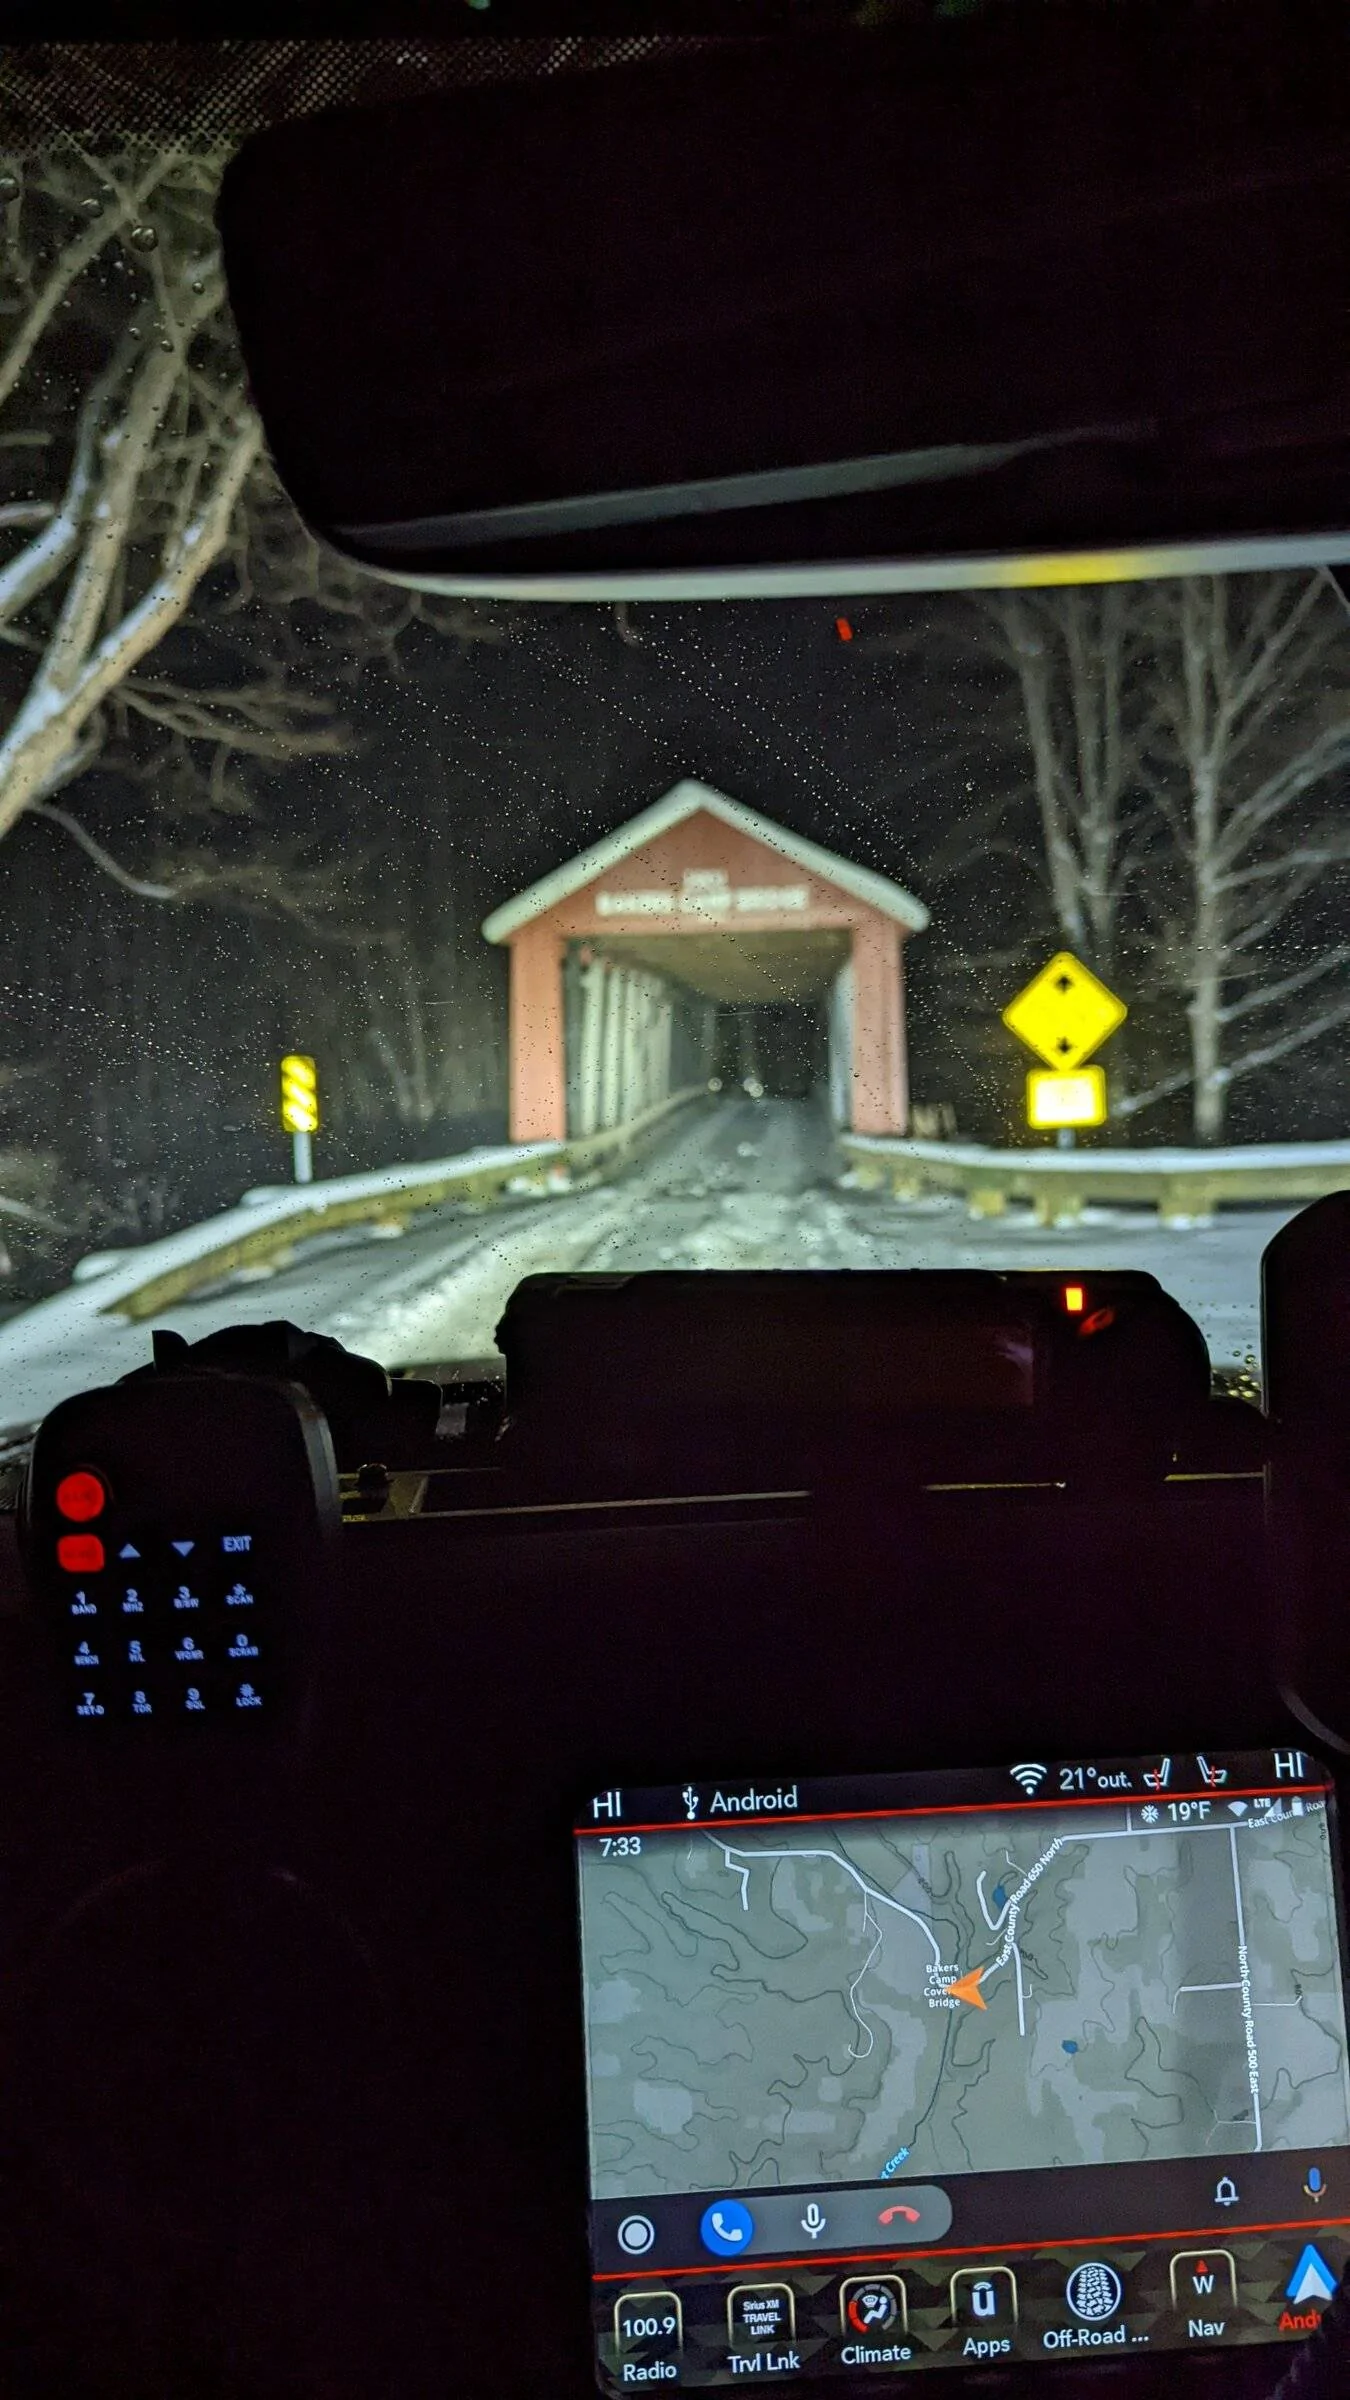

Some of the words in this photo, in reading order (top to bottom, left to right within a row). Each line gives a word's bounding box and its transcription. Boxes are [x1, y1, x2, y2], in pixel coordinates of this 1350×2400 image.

[223, 1536, 252, 1551] EXIT
[76, 1591, 86, 1604] 1
[126, 1588, 138, 1602] 2
[179, 1586, 190, 1599] 3
[226, 1594, 254, 1605] SCAN
[79, 1641, 90, 1655] 4
[183, 1637, 195, 1650] 6
[83, 1692, 95, 1705] 7
[134, 1691, 146, 1703] 8
[187, 1688, 200, 1700] 9
[236, 1696, 262, 1707] LOCK
[1274, 1752, 1304, 1778] HI
[593, 1791, 621, 1818] HI
[710, 1785, 798, 1813] Android
[1253, 1798, 1271, 1808] LTE
[1168, 1801, 1211, 1822] 19°F
[1248, 1816, 1269, 1828] East
[1270, 1809, 1296, 1823] Coun
[600, 1836, 641, 1857] 7:33
[1040, 1838, 1063, 1866] North
[1028, 1863, 1043, 1881] 650
[1010, 1879, 1031, 1904] Road
[1005, 1904, 1020, 1942] County
[996, 1943, 1012, 1967] East
[1238, 1945, 1250, 1977] North
[926, 1964, 959, 1973] Bakers
[929, 1976, 957, 1985] Camp
[928, 1998, 960, 2008] Bridge
[1241, 1979, 1253, 2018] County
[1245, 2020, 1257, 2048] Road
[1248, 2050, 1258, 2069] 500
[1249, 2071, 1259, 2094] East
[886, 2147, 910, 2172] Creek
[1193, 2275, 1214, 2294] W
[743, 2300, 765, 2311] Sirius
[766, 2299, 779, 2309] XM
[622, 2316, 676, 2338] 100.9
[742, 2312, 781, 2323] TRAVEL
[751, 2325, 775, 2335] LINK
[1043, 2325, 1126, 2349] Off-Road
[1189, 2319, 1225, 2338] Nav
[841, 2346, 912, 2366] Climate
[964, 2337, 1010, 2358] Apps
[623, 2362, 677, 2382] Radio
[727, 2354, 761, 2374] Trvl
[767, 2351, 800, 2371] Lnk
